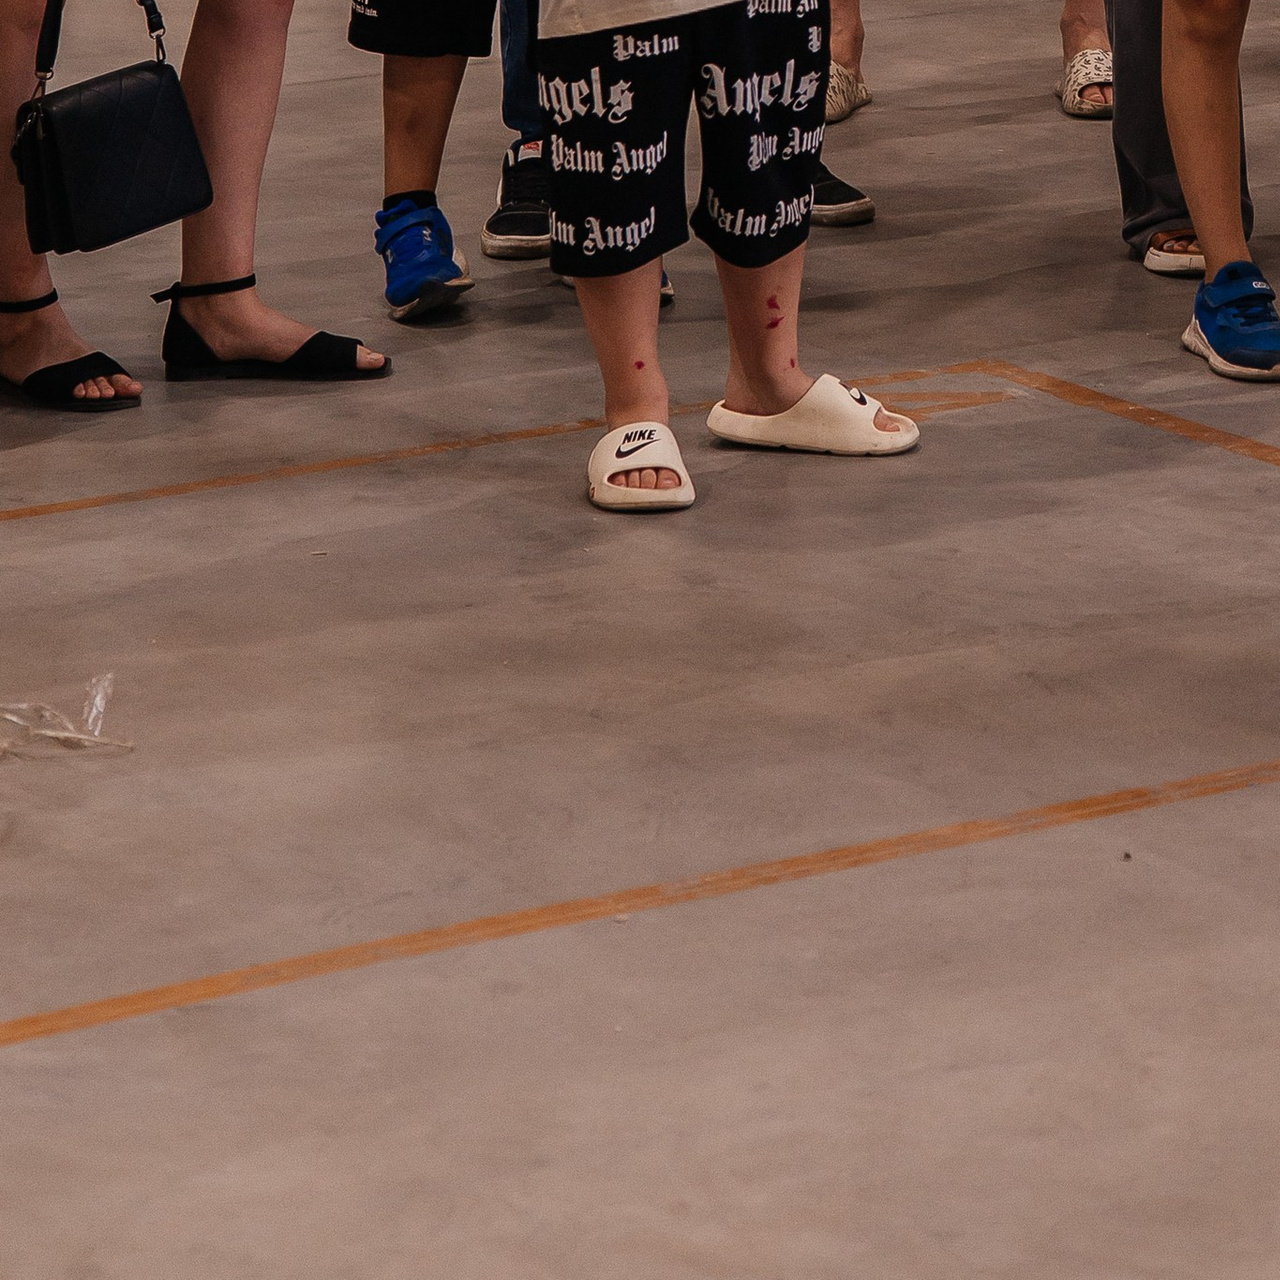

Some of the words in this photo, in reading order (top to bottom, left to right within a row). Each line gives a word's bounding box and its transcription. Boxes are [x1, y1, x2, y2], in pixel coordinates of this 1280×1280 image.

[613, 34, 680, 61] Palm
[538, 66, 635, 126] ngels
[611, 130, 668, 181] Angel
[550, 211, 576, 246] lm
[583, 206, 656, 256] Angel
[768, 184, 815, 238] Angel
[622, 429, 657, 445] NIKE
